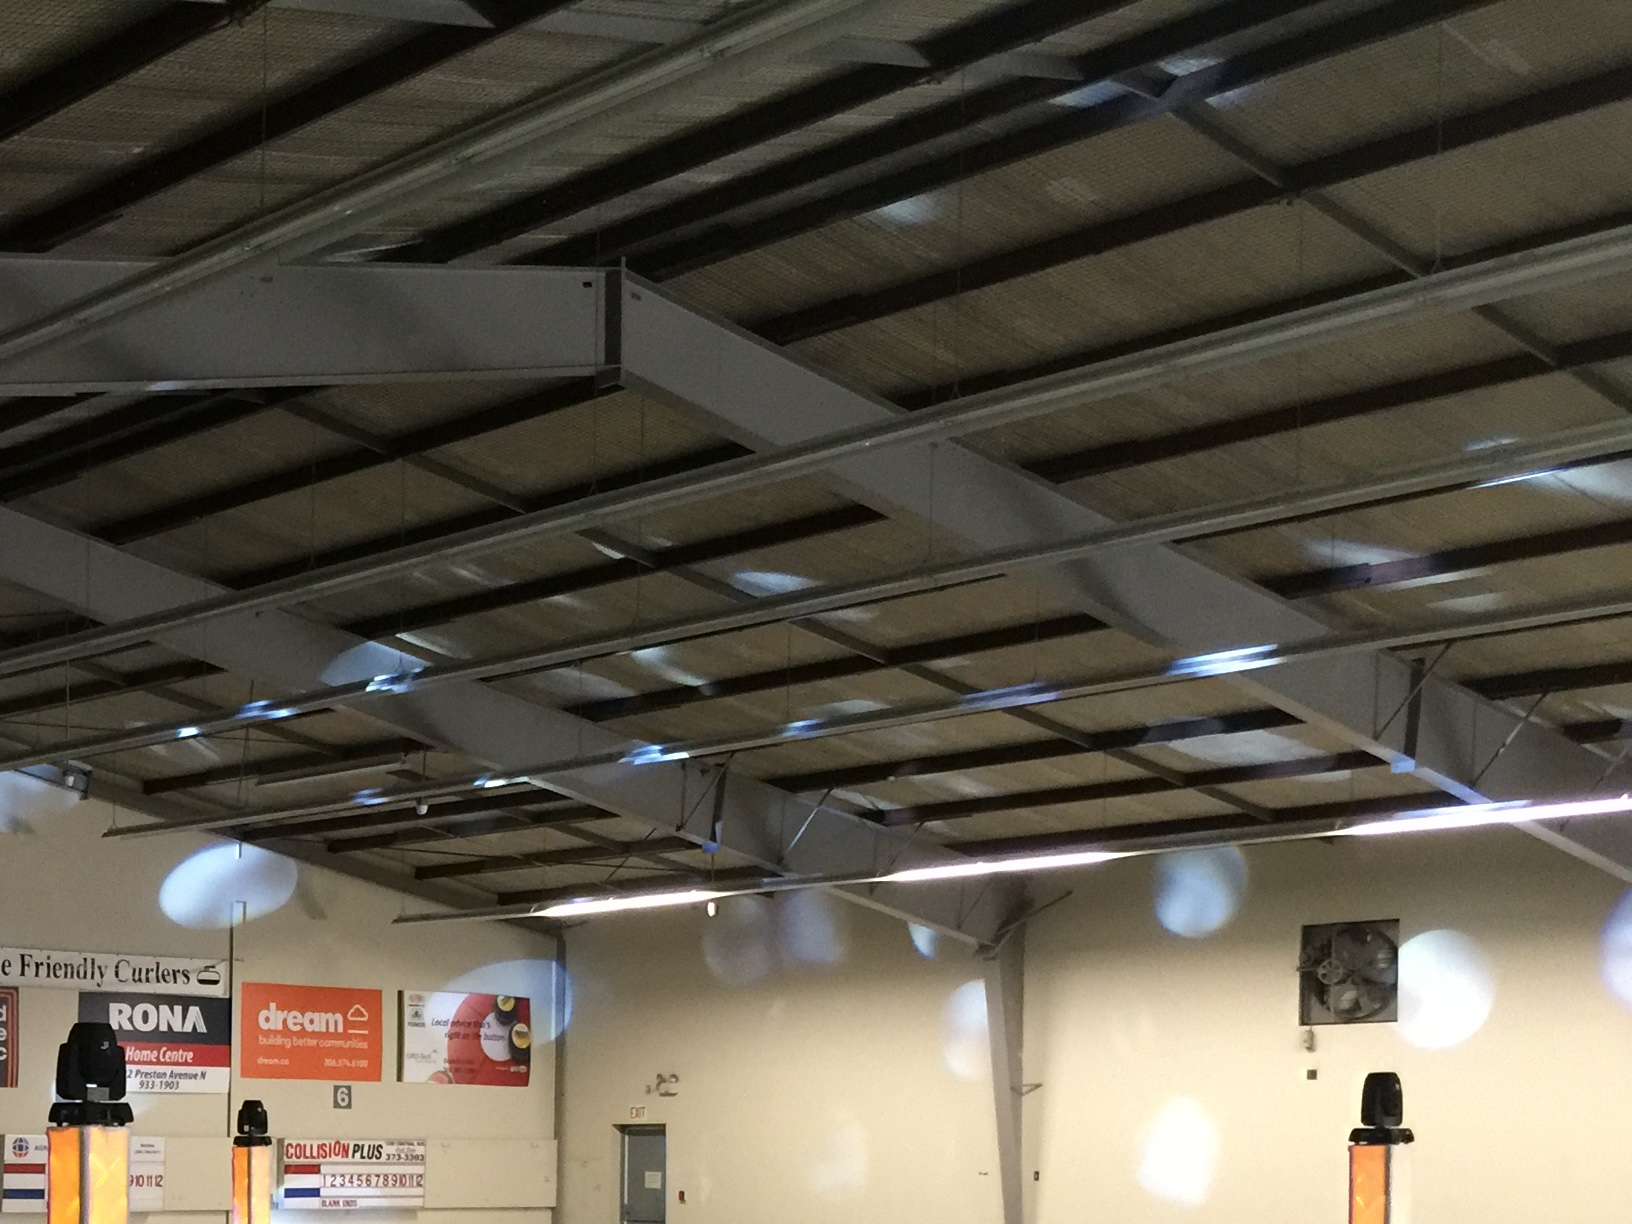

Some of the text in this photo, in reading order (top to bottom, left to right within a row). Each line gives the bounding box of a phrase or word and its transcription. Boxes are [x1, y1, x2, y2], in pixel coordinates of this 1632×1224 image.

[18, 954, 109, 987] Friendly
[114, 959, 190, 985] Curlers
[109, 1003, 207, 1033] RONA
[258, 1002, 344, 1033] dream
[431, 1018, 449, 1028] Local
[258, 1035, 368, 1050] building better communities
[125, 1047, 194, 1063] Home Centre
[135, 1070, 167, 1080] Preston
[169, 1070, 198, 1080] Avenue
[199, 1071, 207, 1080] N
[138, 1080, 179, 1090] 933-1903
[337, 1087, 349, 1107] 6
[630, 1106, 646, 1119] EXIT
[285, 1140, 384, 1160] COLLISION PLUS
[135, 1174, 145, 1187] 10
[146, 1174, 153, 1187] 11
[155, 1174, 164, 1187] 12
[331, 1175, 337, 1187] 2
[340, 1175, 346, 1187] 3
[348, 1175, 354, 1187] 4
[357, 1175, 363, 1187] 5
[366, 1175, 372, 1187] 6
[375, 1175, 381, 1187] 7
[382, 1175, 389, 1187] 8
[392, 1175, 398, 1187] 9
[399, 1175, 407, 1187] 10
[409, 1175, 414, 1187] 11
[416, 1175, 423, 1187] 12
[322, 1199, 341, 1207] BLANK
